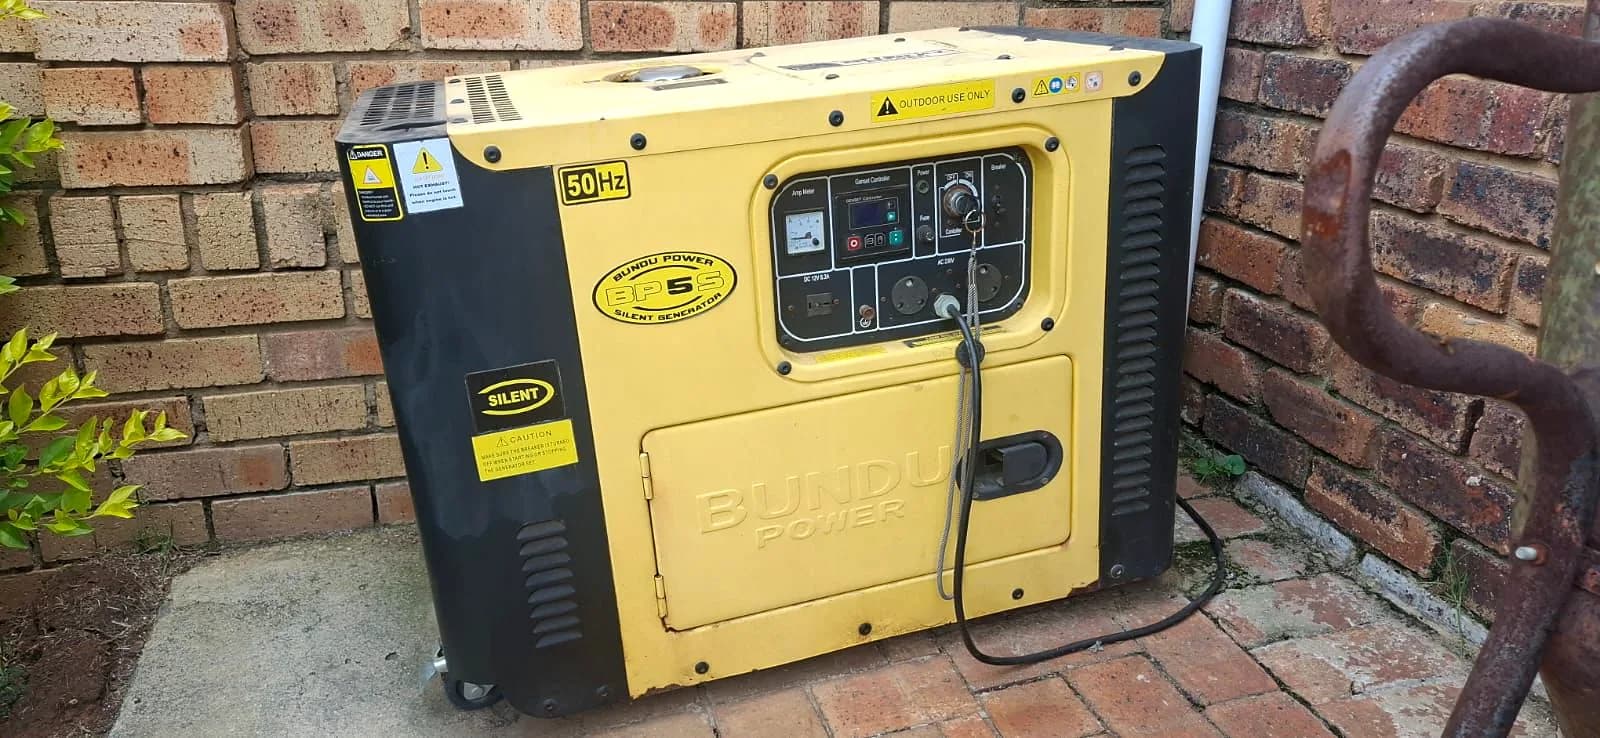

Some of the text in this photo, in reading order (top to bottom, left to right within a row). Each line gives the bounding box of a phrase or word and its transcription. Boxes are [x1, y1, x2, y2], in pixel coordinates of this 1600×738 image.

[899, 89, 991, 110] OUTDOOR USE ONLY
[357, 150, 383, 158] DANGER
[792, 189, 802, 198] Amp
[612, 254, 714, 283] BUNDU POWER
[614, 292, 722, 321] SILENT GENERATOR
[488, 388, 539, 407] SILENT
[510, 430, 552, 444] CAUTION
[520, 444, 544, 452] BREAKER
[494, 462, 525, 472] GENERATOR
[696, 445, 951, 535] BUNDU
[754, 499, 905, 550] POWER
